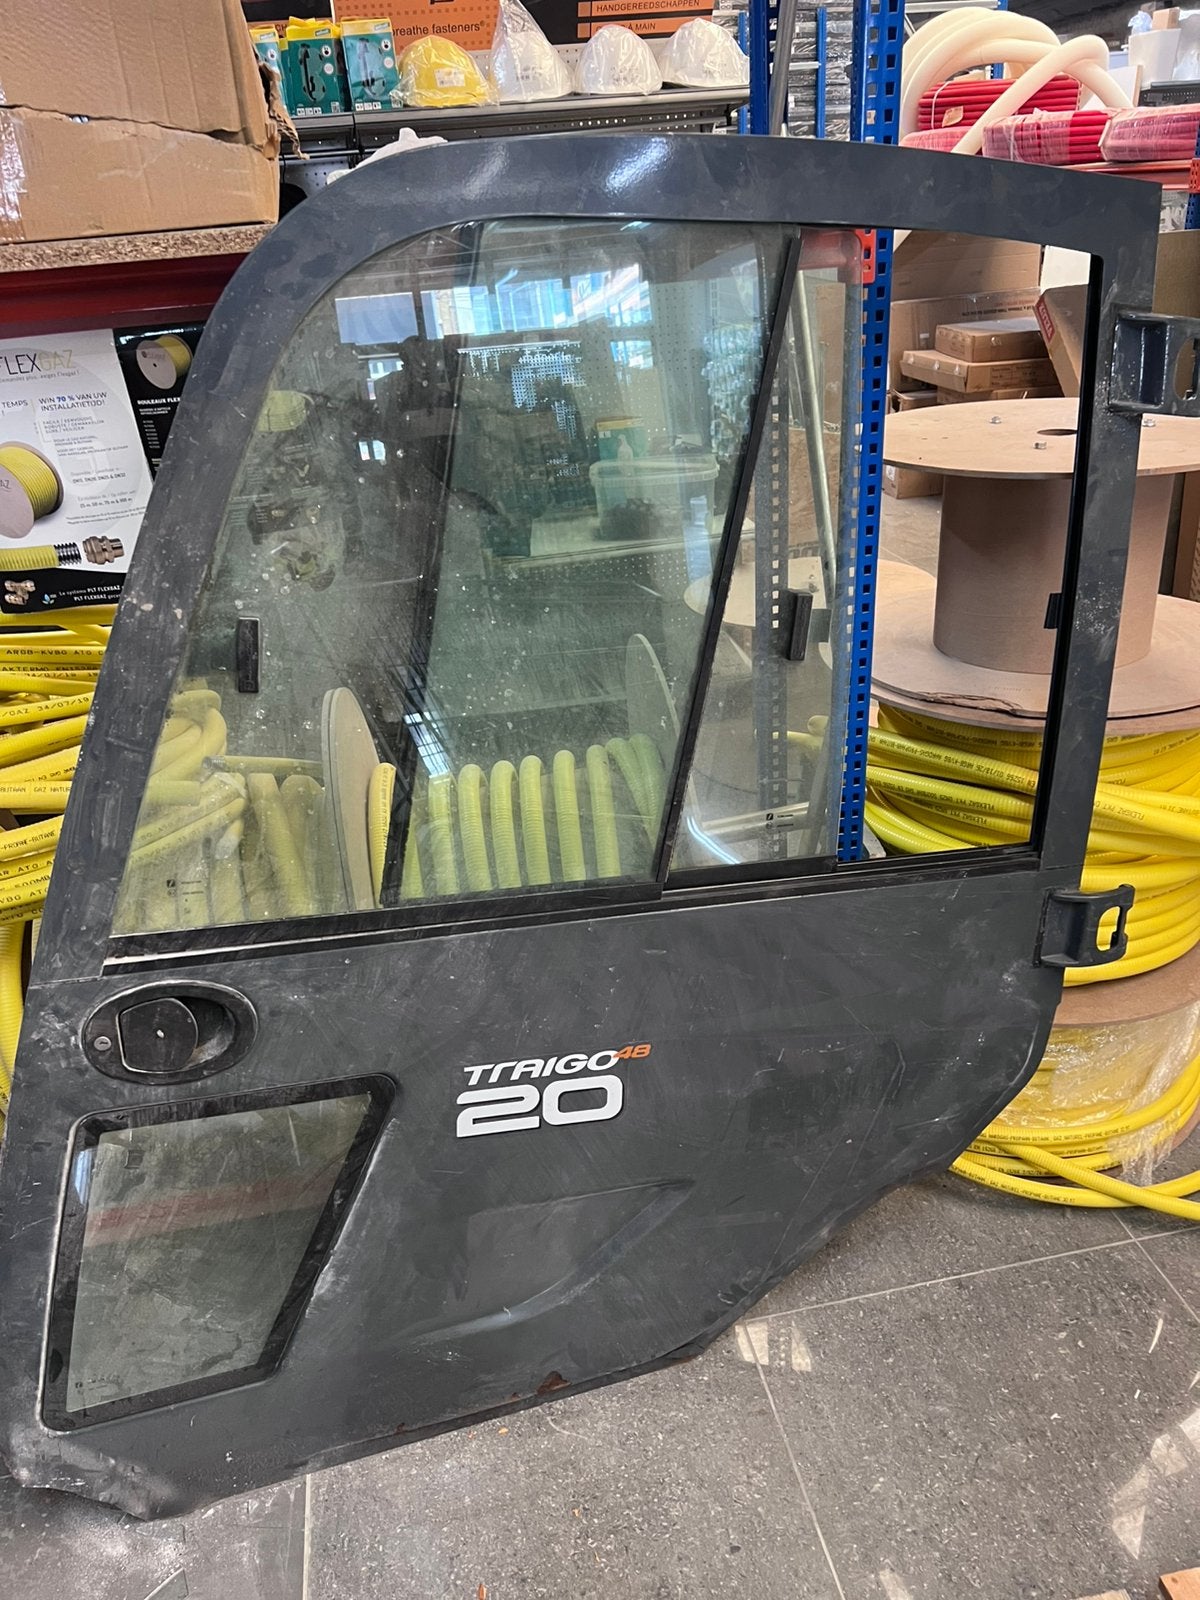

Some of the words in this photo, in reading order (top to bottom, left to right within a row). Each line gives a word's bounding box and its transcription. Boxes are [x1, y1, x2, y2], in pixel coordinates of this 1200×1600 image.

[596, 0, 700, 12] HANDGEREEDSCHAPPEN
[635, 23, 656, 31] MAIN
[0, 349, 75, 375] LEXGAZ
[2, 400, 29, 409] TEMPS
[39, 397, 55, 405] WIN
[56, 395, 66, 403] 70
[75, 393, 92, 401] VAN
[613, 1043, 652, 1059] 48
[456, 1074, 624, 1138] 20
